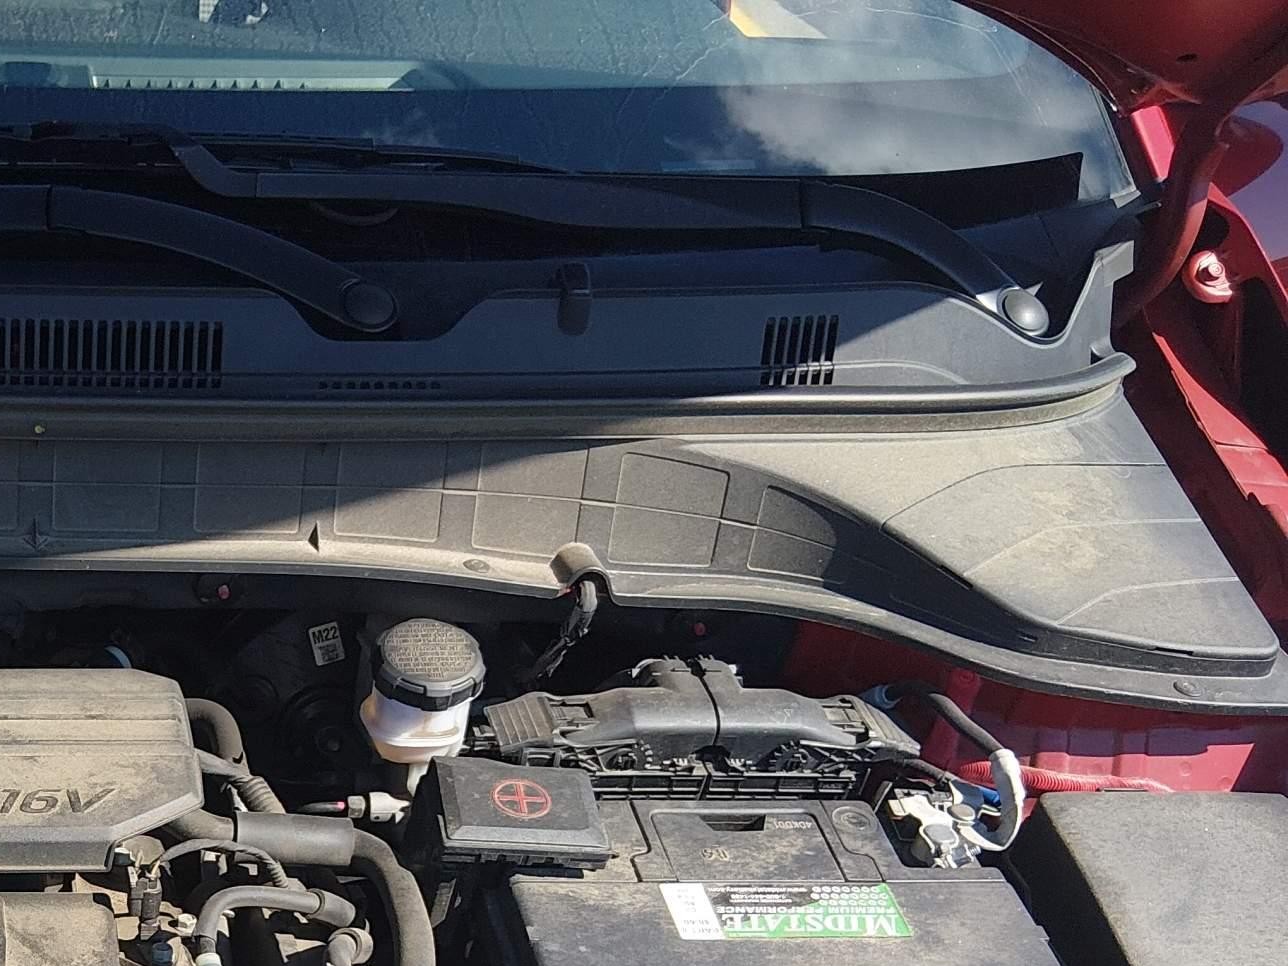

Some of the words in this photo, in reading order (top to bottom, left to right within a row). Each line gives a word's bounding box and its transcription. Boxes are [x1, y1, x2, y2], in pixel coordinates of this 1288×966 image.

[311, 626, 339, 645] M22
[0, 788, 118, 815] 16V
[716, 905, 824, 915] PERFORMANCE
[828, 906, 895, 915] PREMIUM
[721, 912, 899, 938] MIDSTATE
